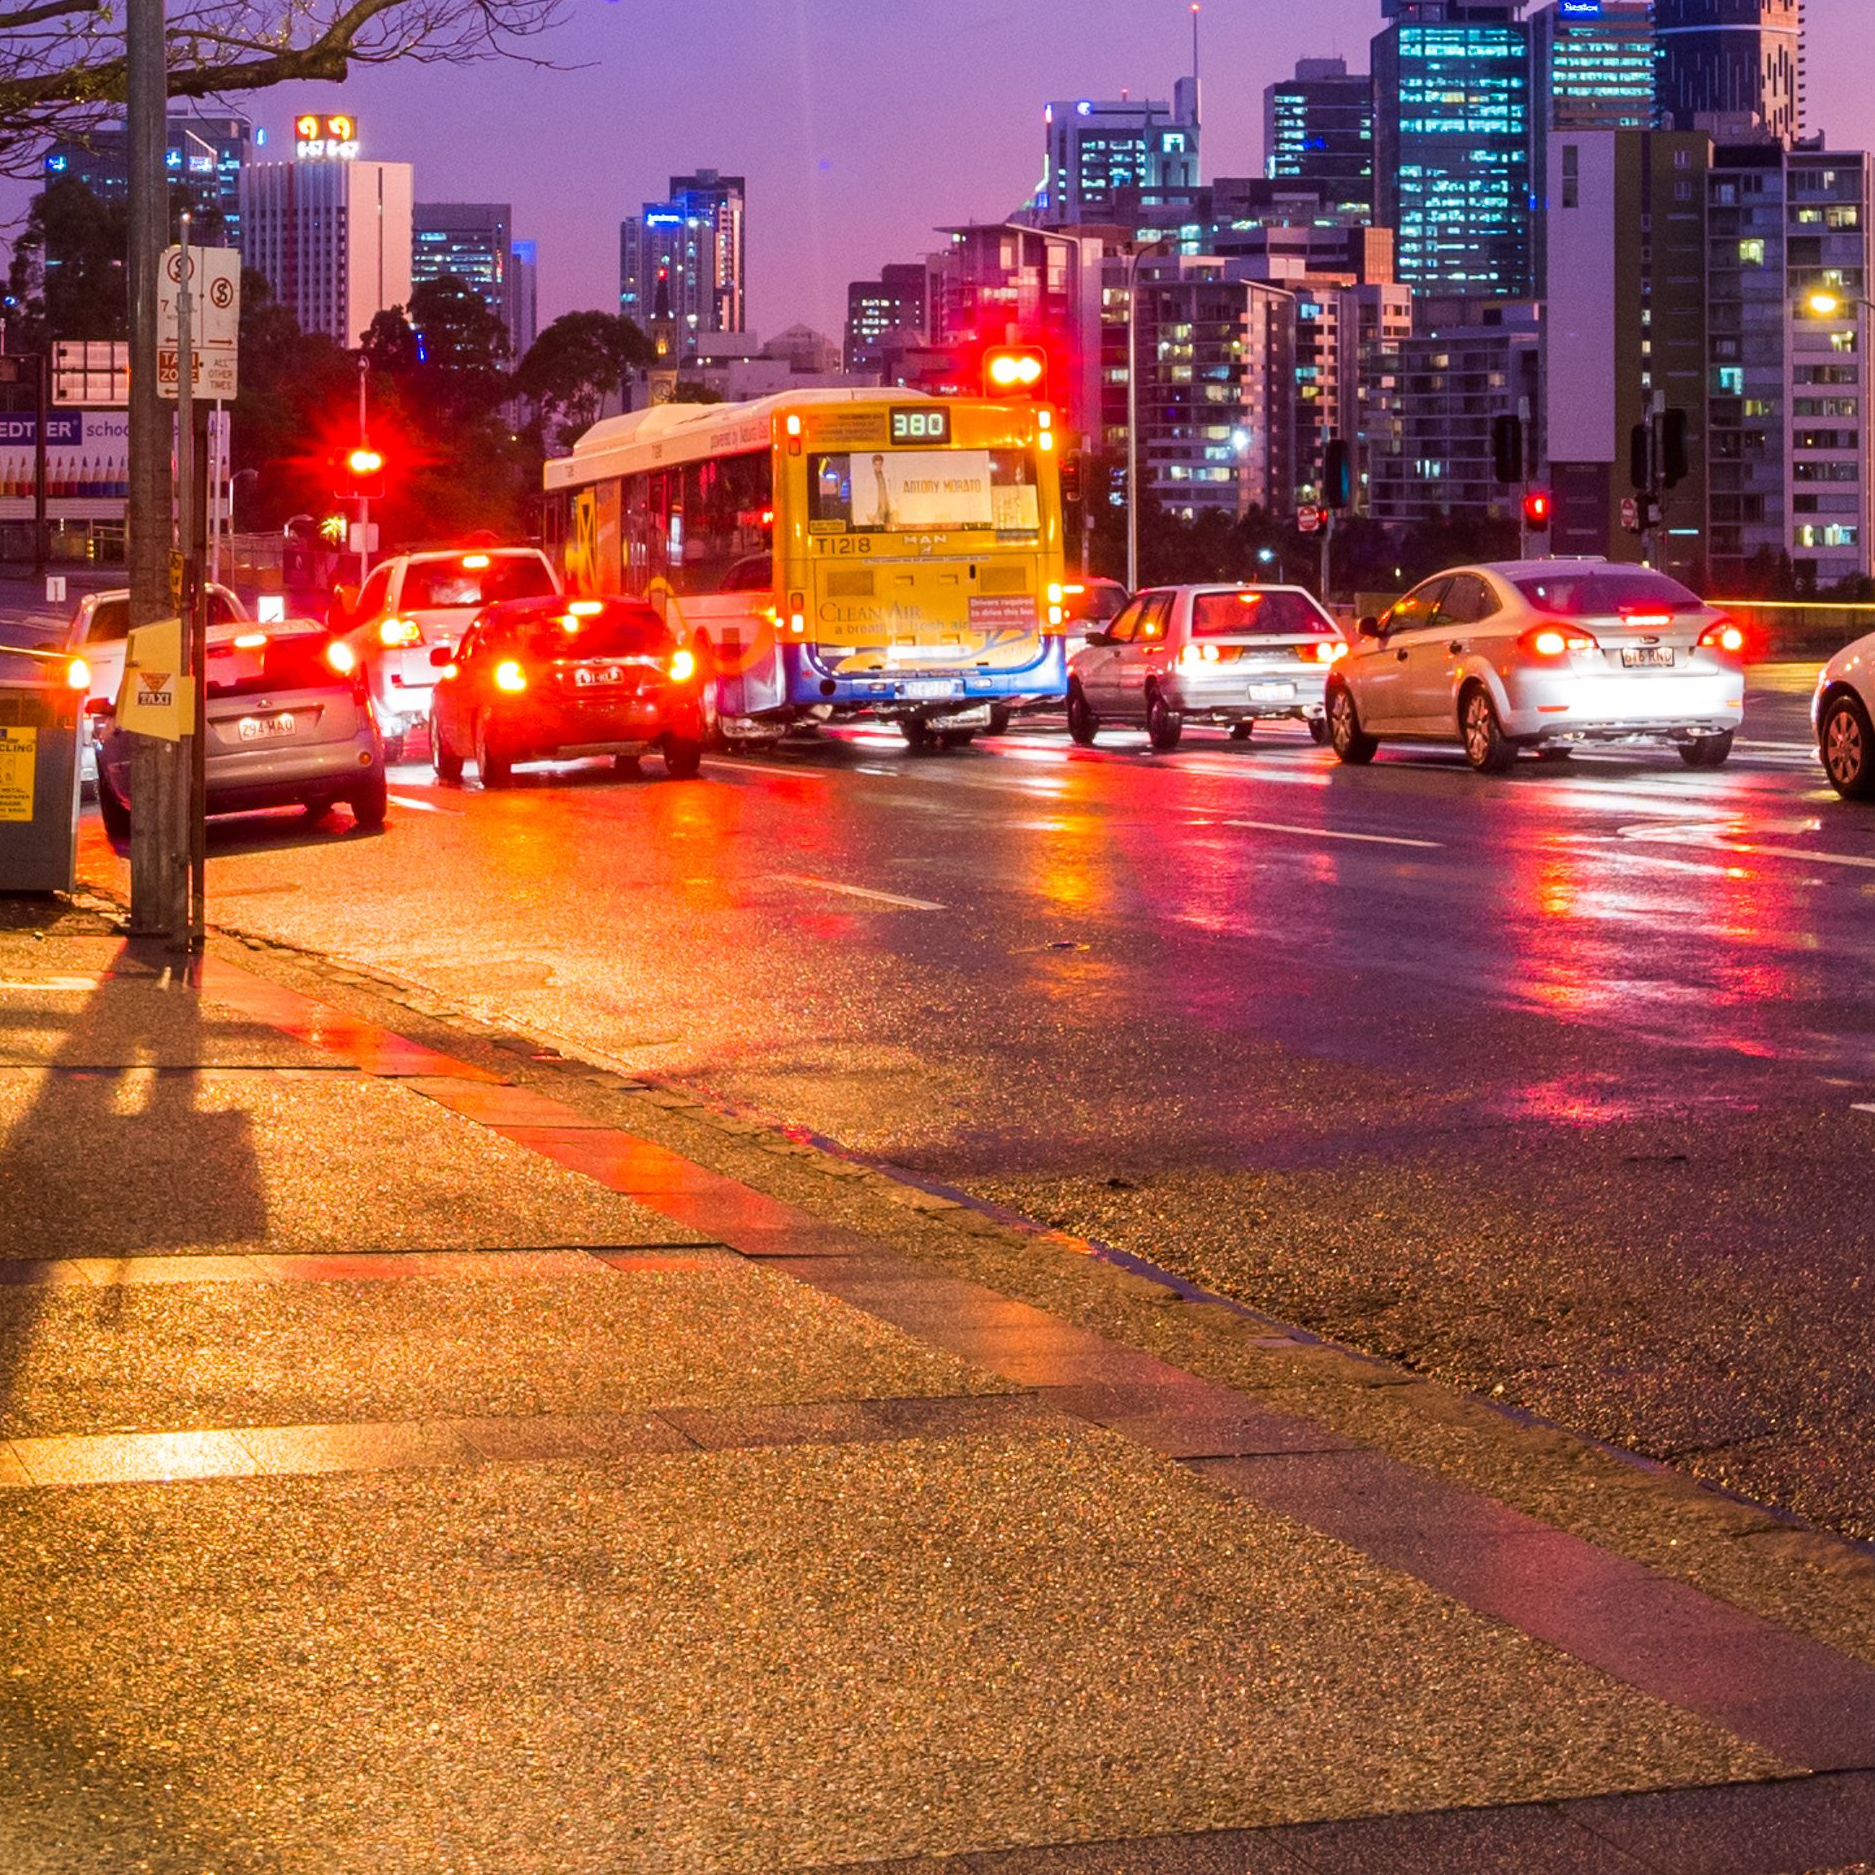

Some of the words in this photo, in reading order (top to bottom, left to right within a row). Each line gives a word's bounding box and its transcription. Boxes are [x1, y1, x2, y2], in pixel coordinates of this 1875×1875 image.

[161, 352, 197, 367] TAI
[214, 358, 229, 367] ALL
[160, 368, 198, 382] ZOE
[208, 370, 233, 379] OTHER
[210, 381, 232, 391] TIMES
[893, 413, 944, 437] 380
[902, 479, 939, 494] ANTONY
[943, 478, 982, 494] MORATO
[904, 535, 947, 544] MAN
[816, 538, 872, 555] T1218
[970, 598, 999, 606] Drivers
[1000, 597, 1034, 607] required
[971, 609, 980, 617] to
[981, 608, 1003, 616] drive
[1004, 607, 1018, 616] this
[1019, 607, 1034, 615] bus
[139, 693, 170, 705] TAXI
